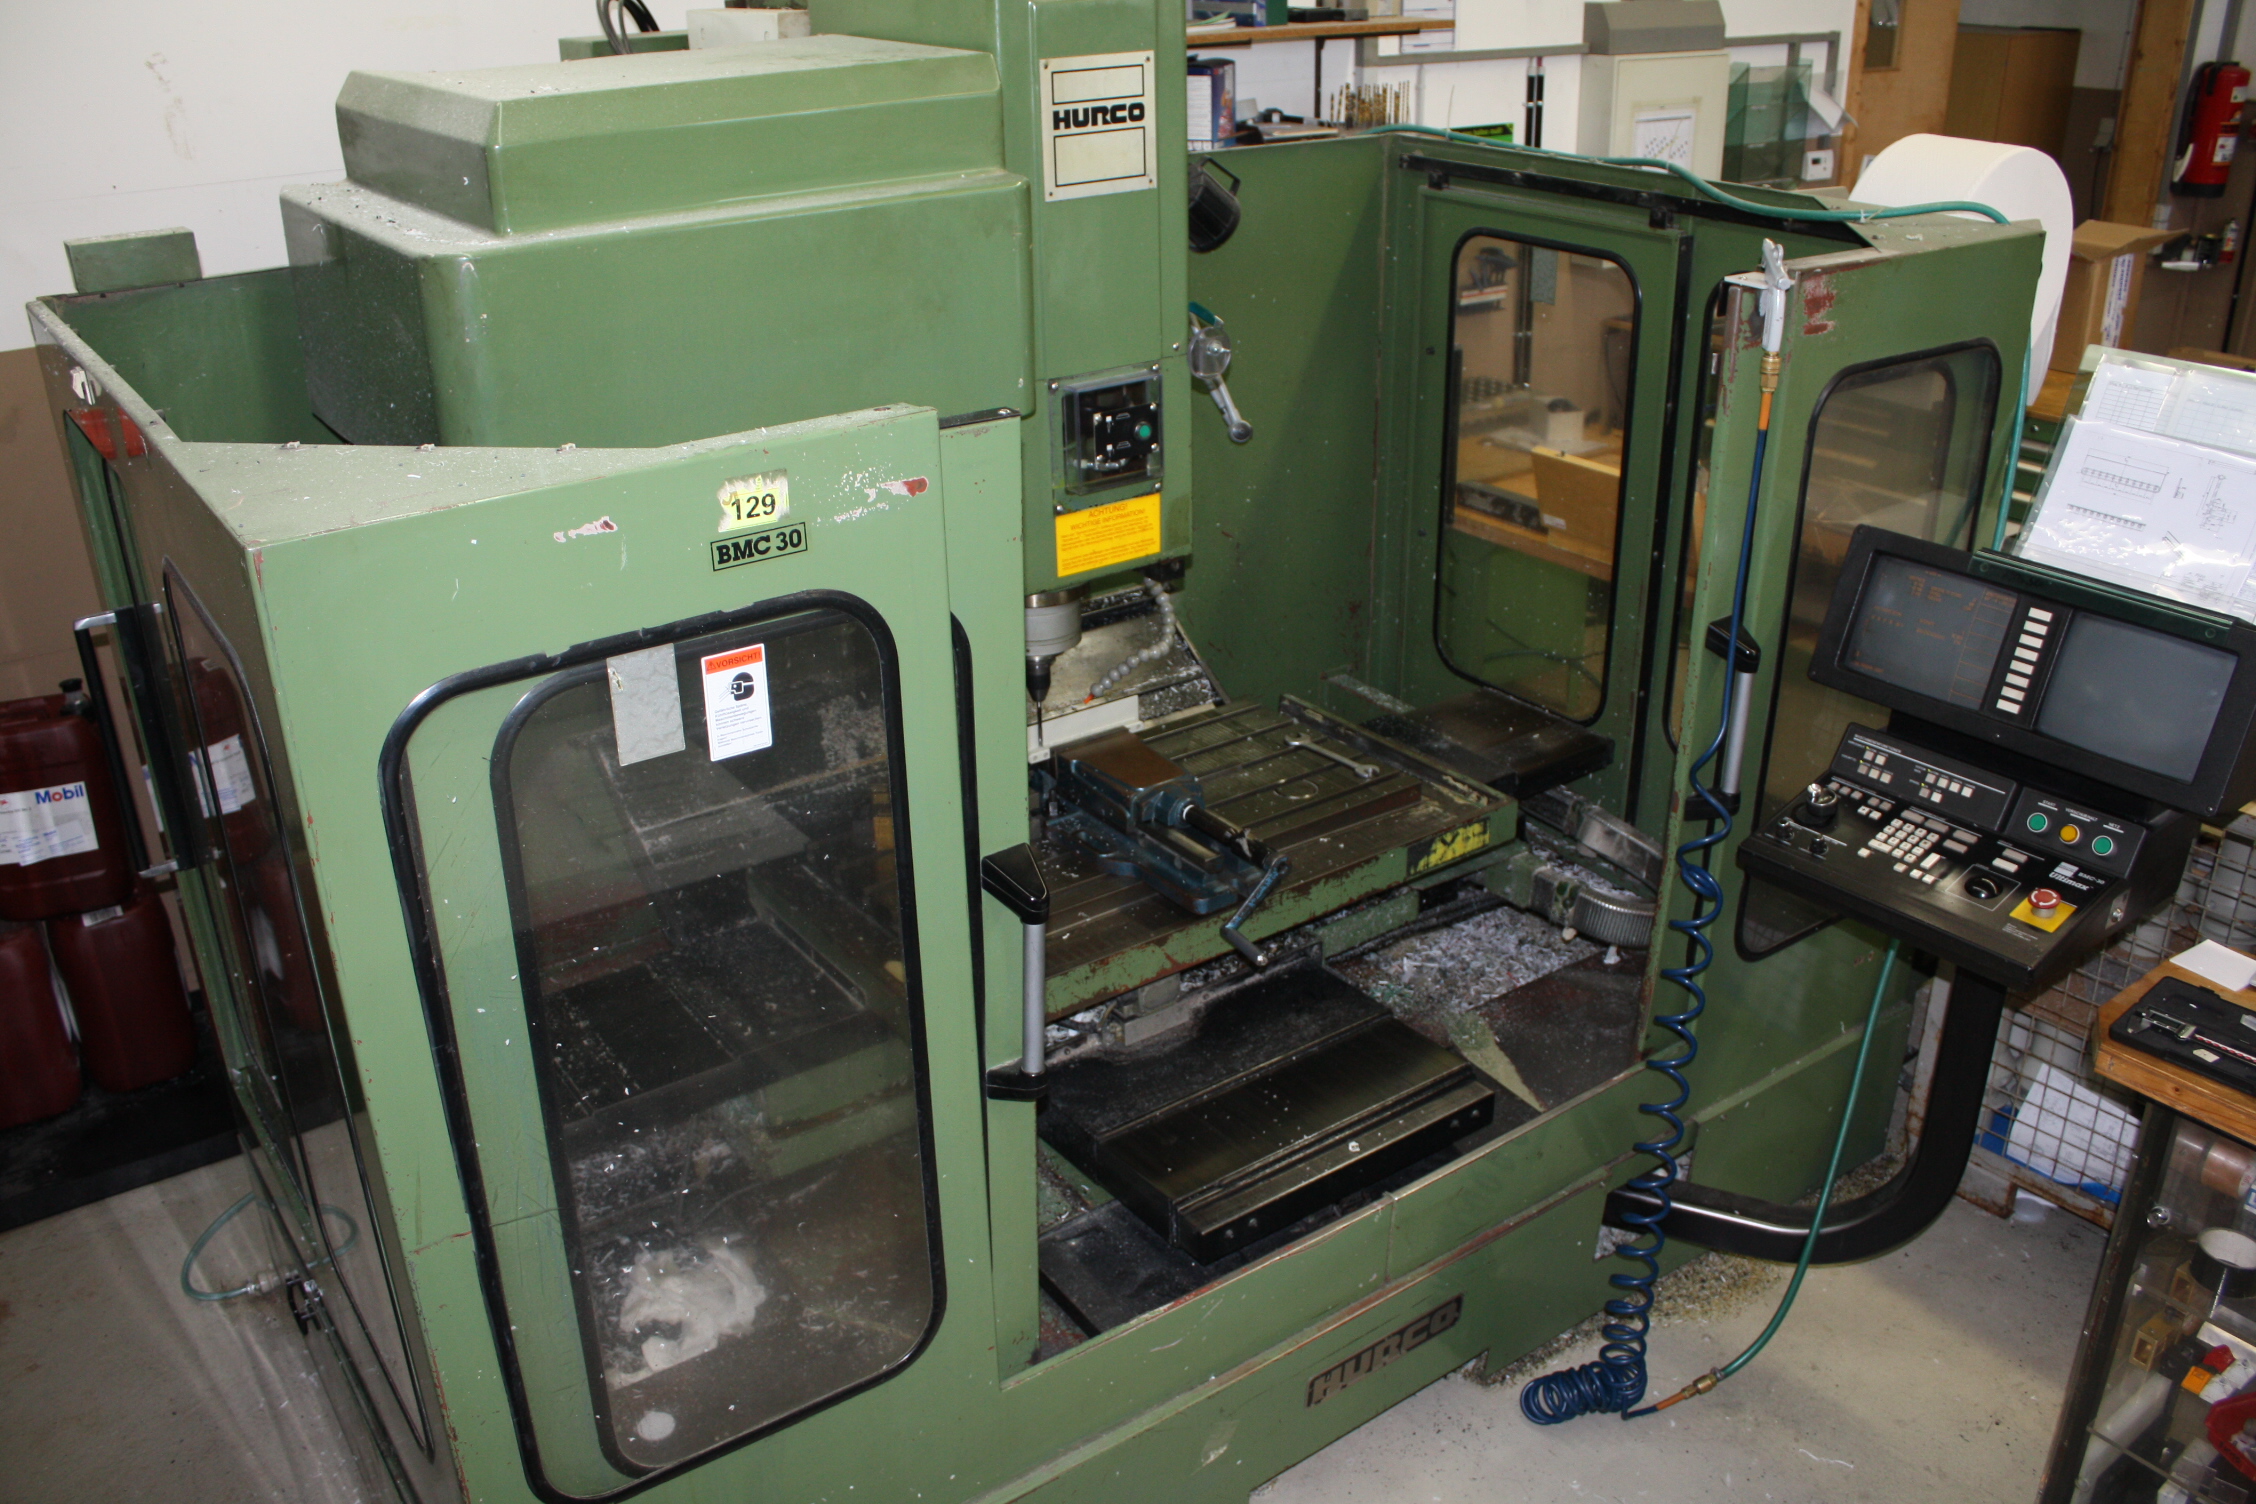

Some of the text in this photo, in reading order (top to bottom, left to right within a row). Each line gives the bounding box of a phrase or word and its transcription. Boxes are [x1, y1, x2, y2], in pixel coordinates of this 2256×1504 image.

[1053, 101, 1145, 130] HURCO
[731, 493, 776, 521] 129
[716, 528, 802, 565] BMC 30
[716, 652, 761, 667] VORSICHT!
[35, 784, 85, 805] Mobil
